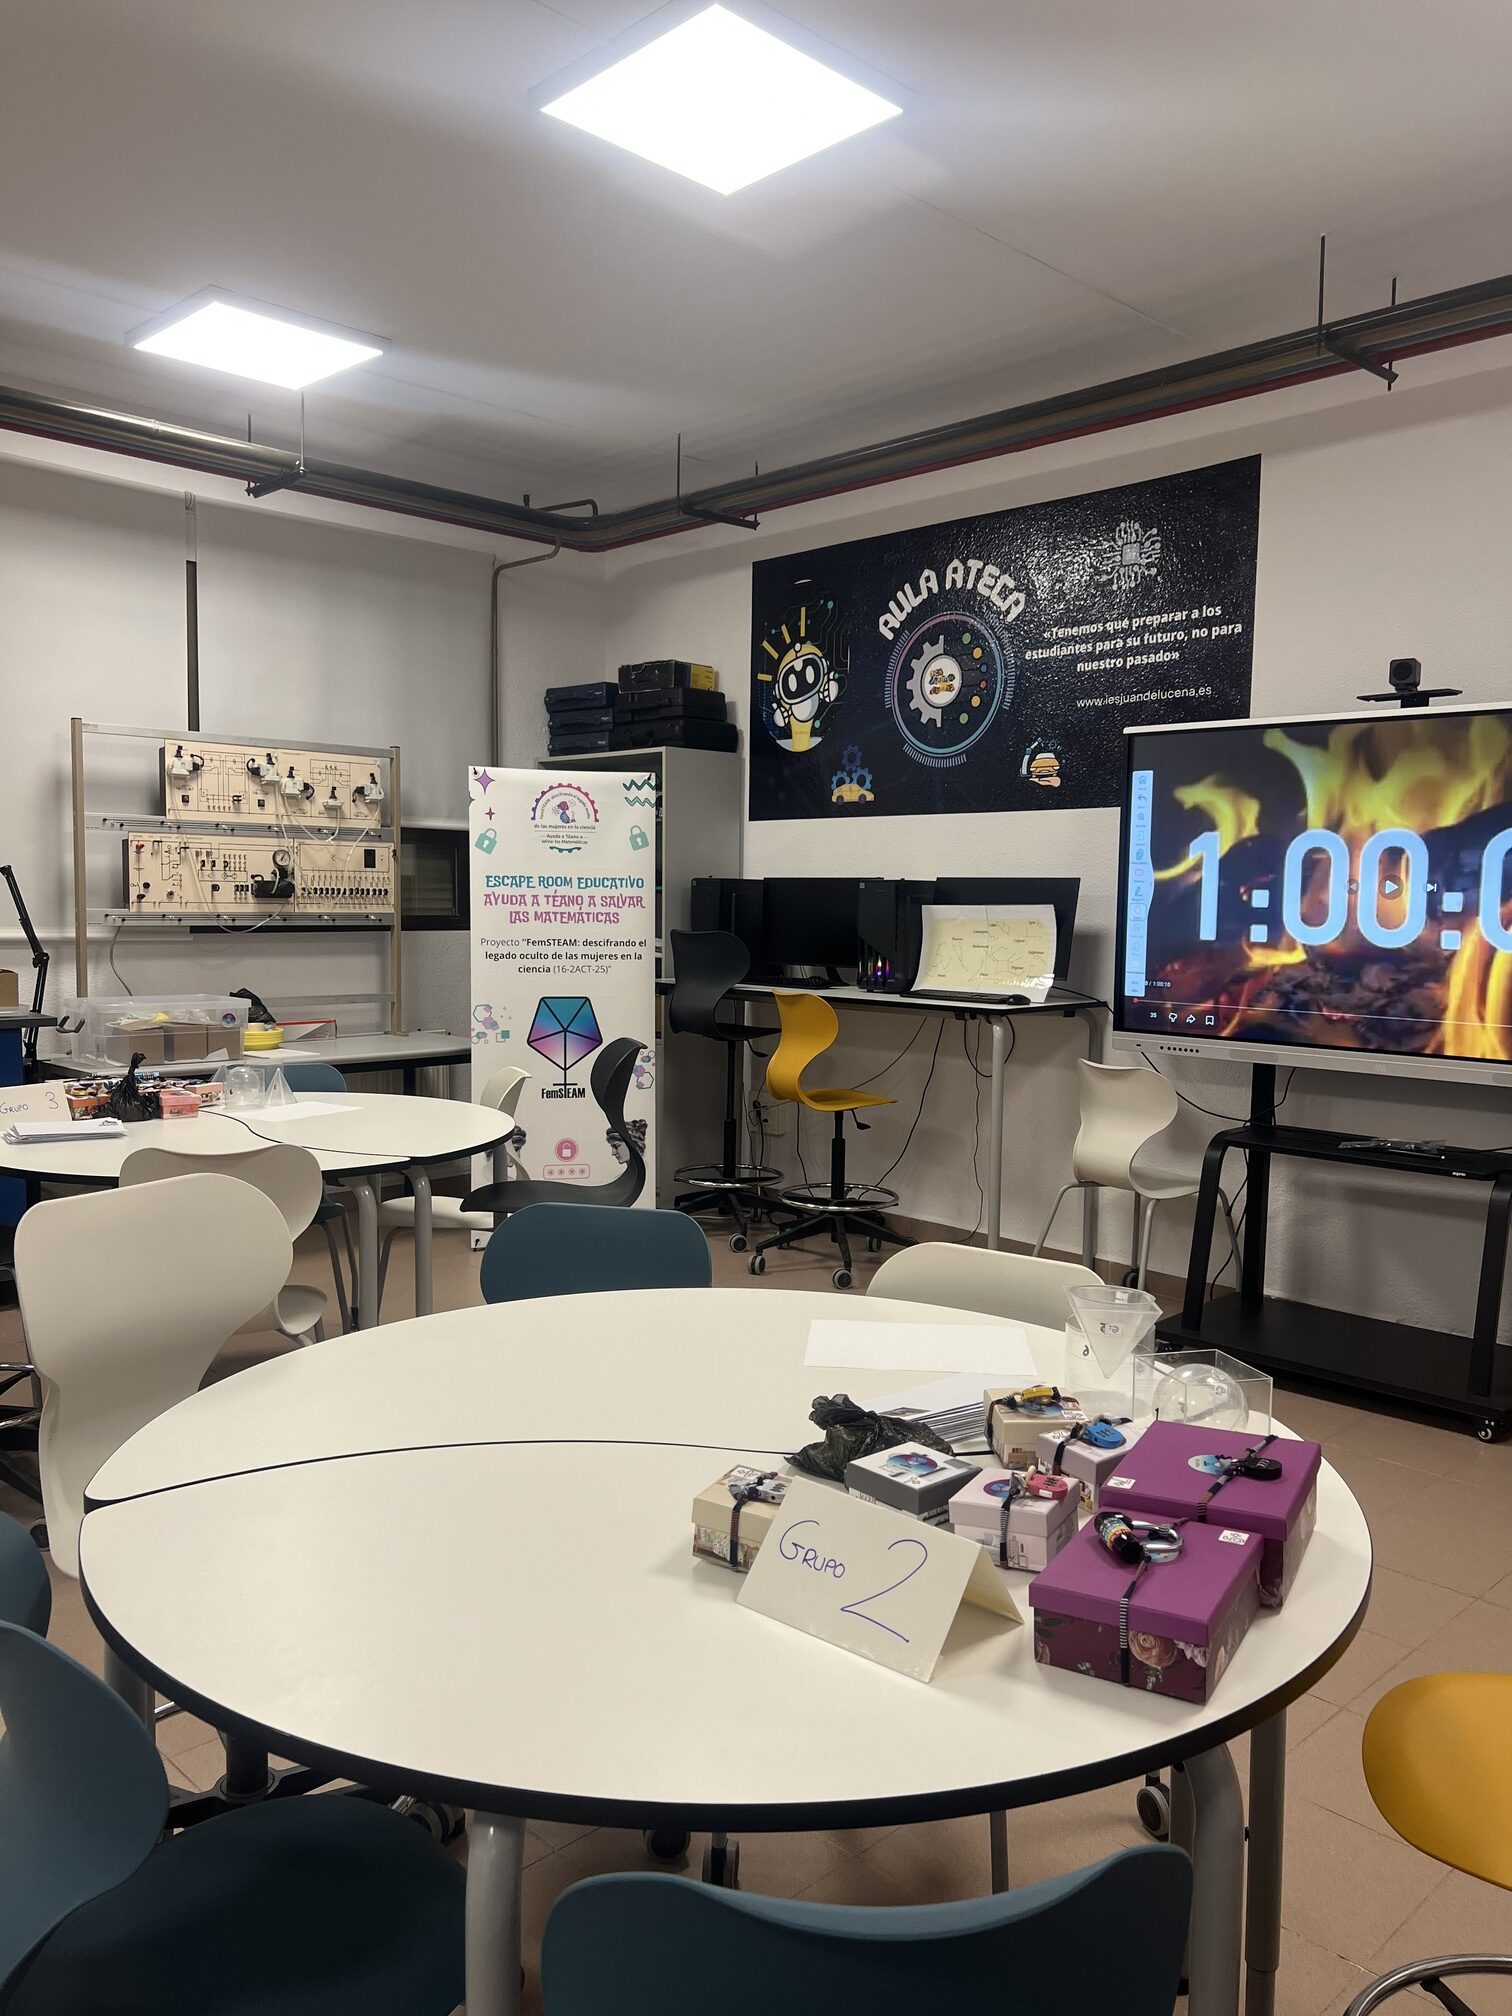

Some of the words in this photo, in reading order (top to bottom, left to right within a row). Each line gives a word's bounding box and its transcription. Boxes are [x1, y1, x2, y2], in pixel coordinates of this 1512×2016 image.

[879, 568, 939, 641] AULA
[945, 558, 1026, 623] ATECA
[1104, 619, 1129, 634] que
[1132, 611, 1188, 630] preparar
[1191, 609, 1200, 619] a
[1202, 605, 1222, 617] los
[1025, 642, 1093, 660] estudiantes
[1095, 638, 1124, 654] para
[1126, 635, 1141, 647] su
[1143, 630, 1189, 646] futuro,
[1191, 628, 1209, 639] no
[1211, 623, 1243, 639] para
[1076, 657, 1124, 672] nuestro
[1126, 650, 1180, 669] pasado»
[1076, 685, 1212, 708] www.iesjuandelucena.es
[485, 875, 536, 889] ESCAPE
[538, 876, 573, 889] ROOM
[577, 875, 645, 890] EDUCATIVO
[484, 891, 528, 906] AYUDA
[531, 894, 540, 907] A
[544, 889, 584, 908] TÉANO
[587, 895, 597, 908] A
[600, 893, 646, 909] SALVAR
[509, 910, 530, 924] LAS
[534, 906, 620, 924] MATEMÁTICAS
[480, 937, 520, 948] Proyecto
[582, 938, 637, 948] descifrando
[638, 939, 647, 948] el
[485, 951, 517, 962] legado
[519, 951, 549, 960] oculto
[551, 952, 563, 960] de
[565, 952, 579, 961] las
[580, 952, 619, 962] mujeres
[620, 953, 632, 961] en
[634, 952, 643, 961] la
[517, 965, 551, 974] ciencia
[44, 1091, 59, 1110] 3
[541, 1084, 586, 1099] FemSTEAM
[840, 1539, 928, 1644] 2
